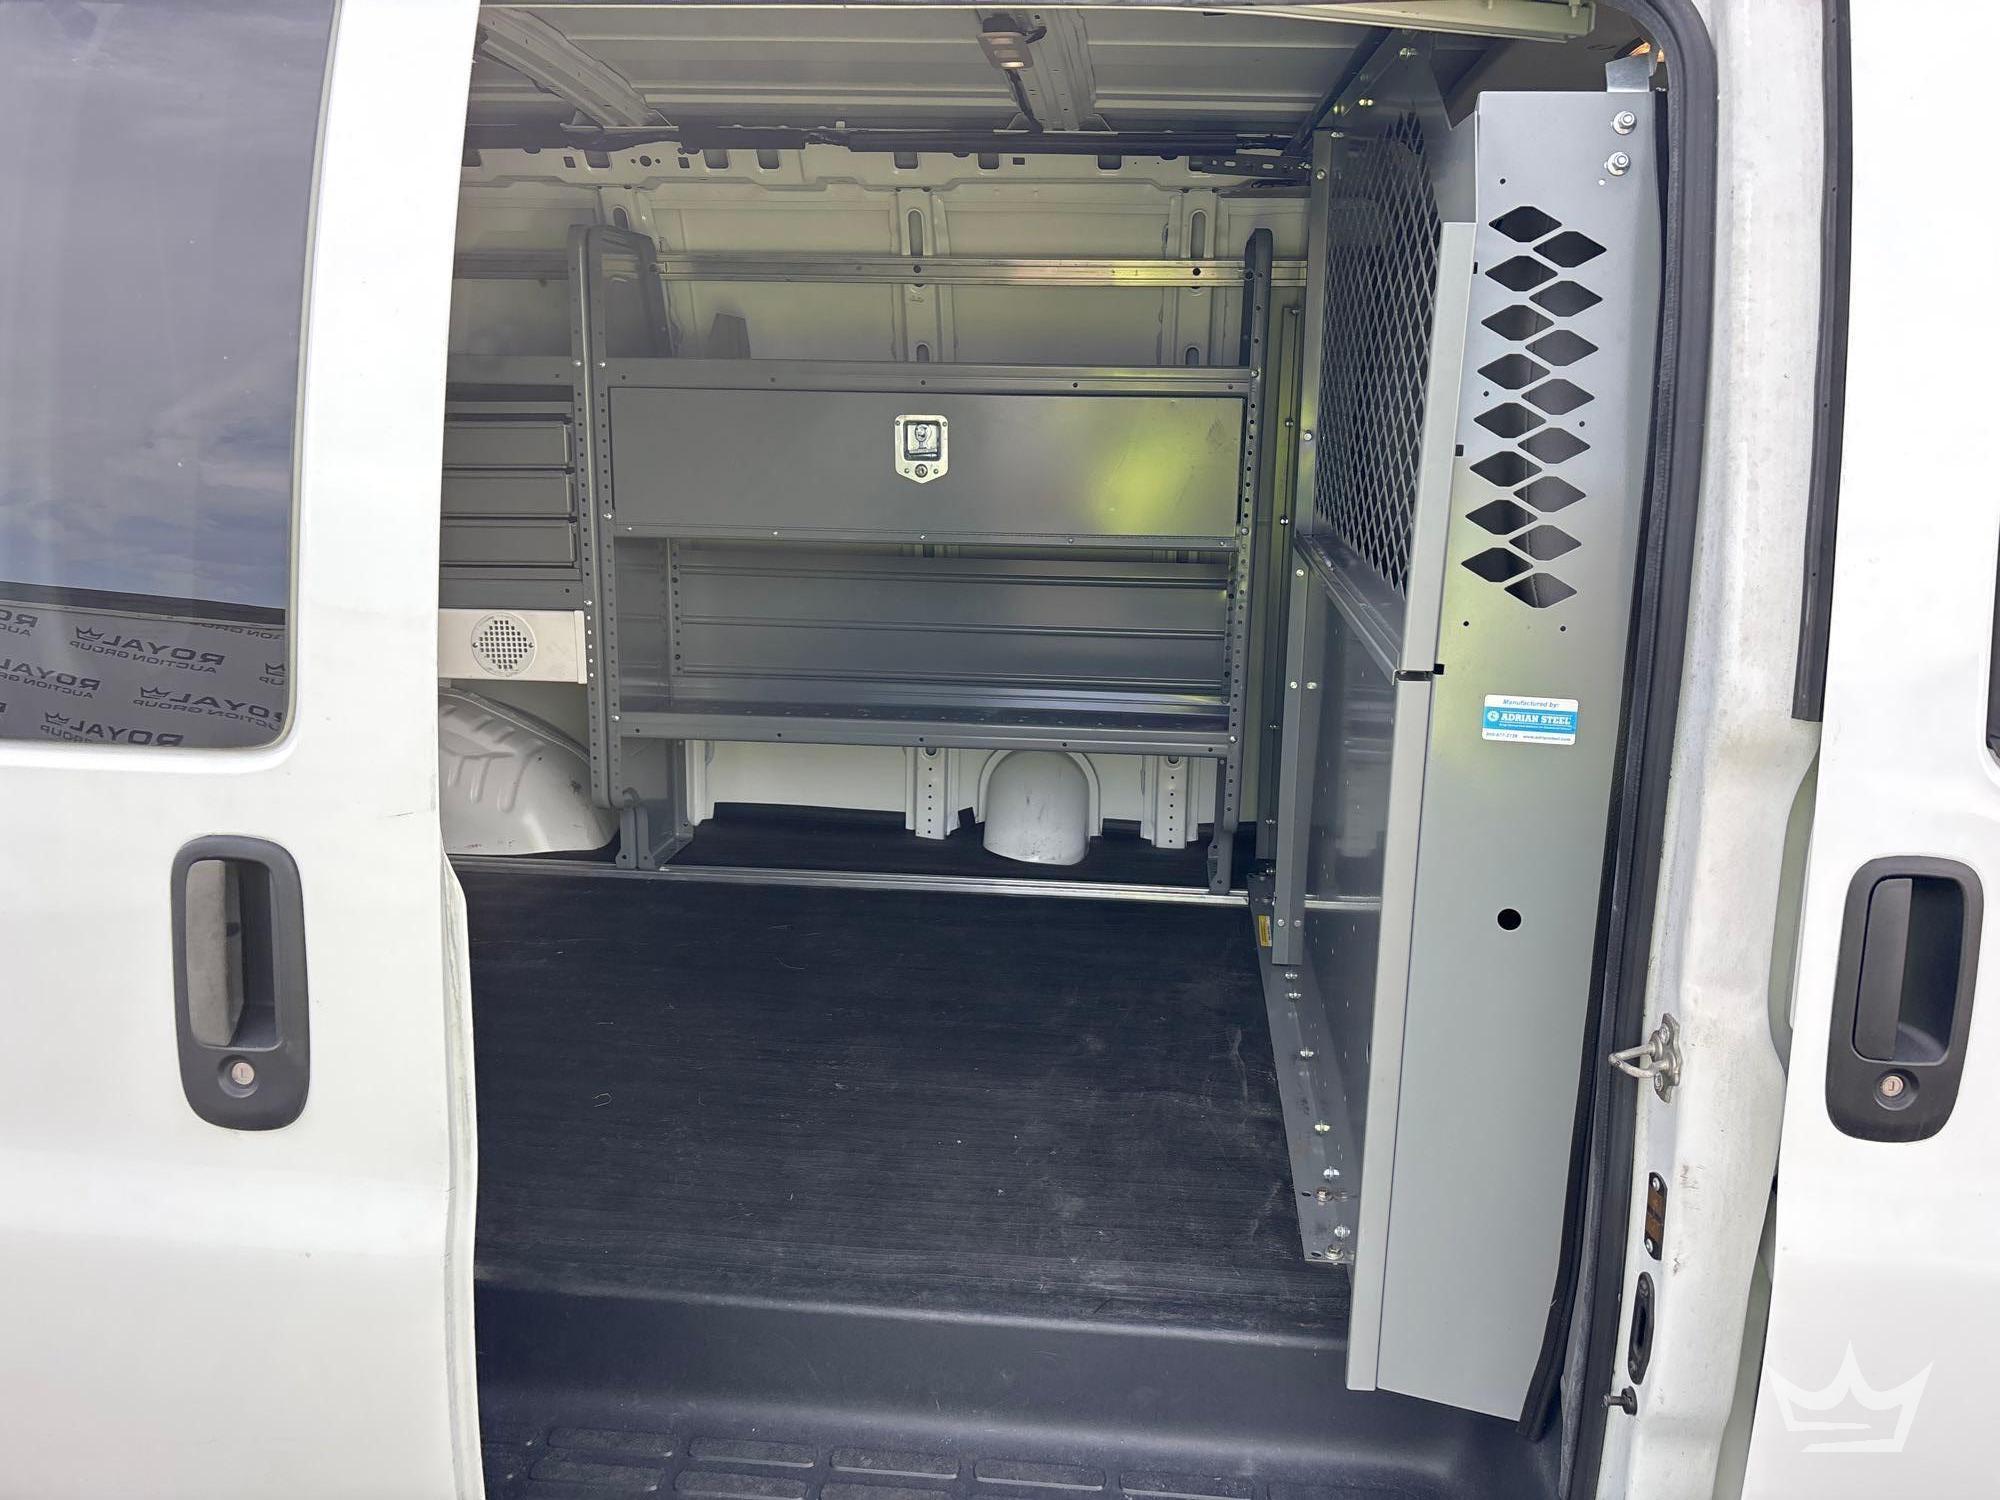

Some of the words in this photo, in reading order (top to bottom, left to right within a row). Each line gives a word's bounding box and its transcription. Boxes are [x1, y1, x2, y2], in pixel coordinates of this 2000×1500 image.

[1502, 699, 1547, 708] Manufactured
[1501, 713, 1539, 723] ADRIAN
[1541, 715, 1571, 725] STEEL
